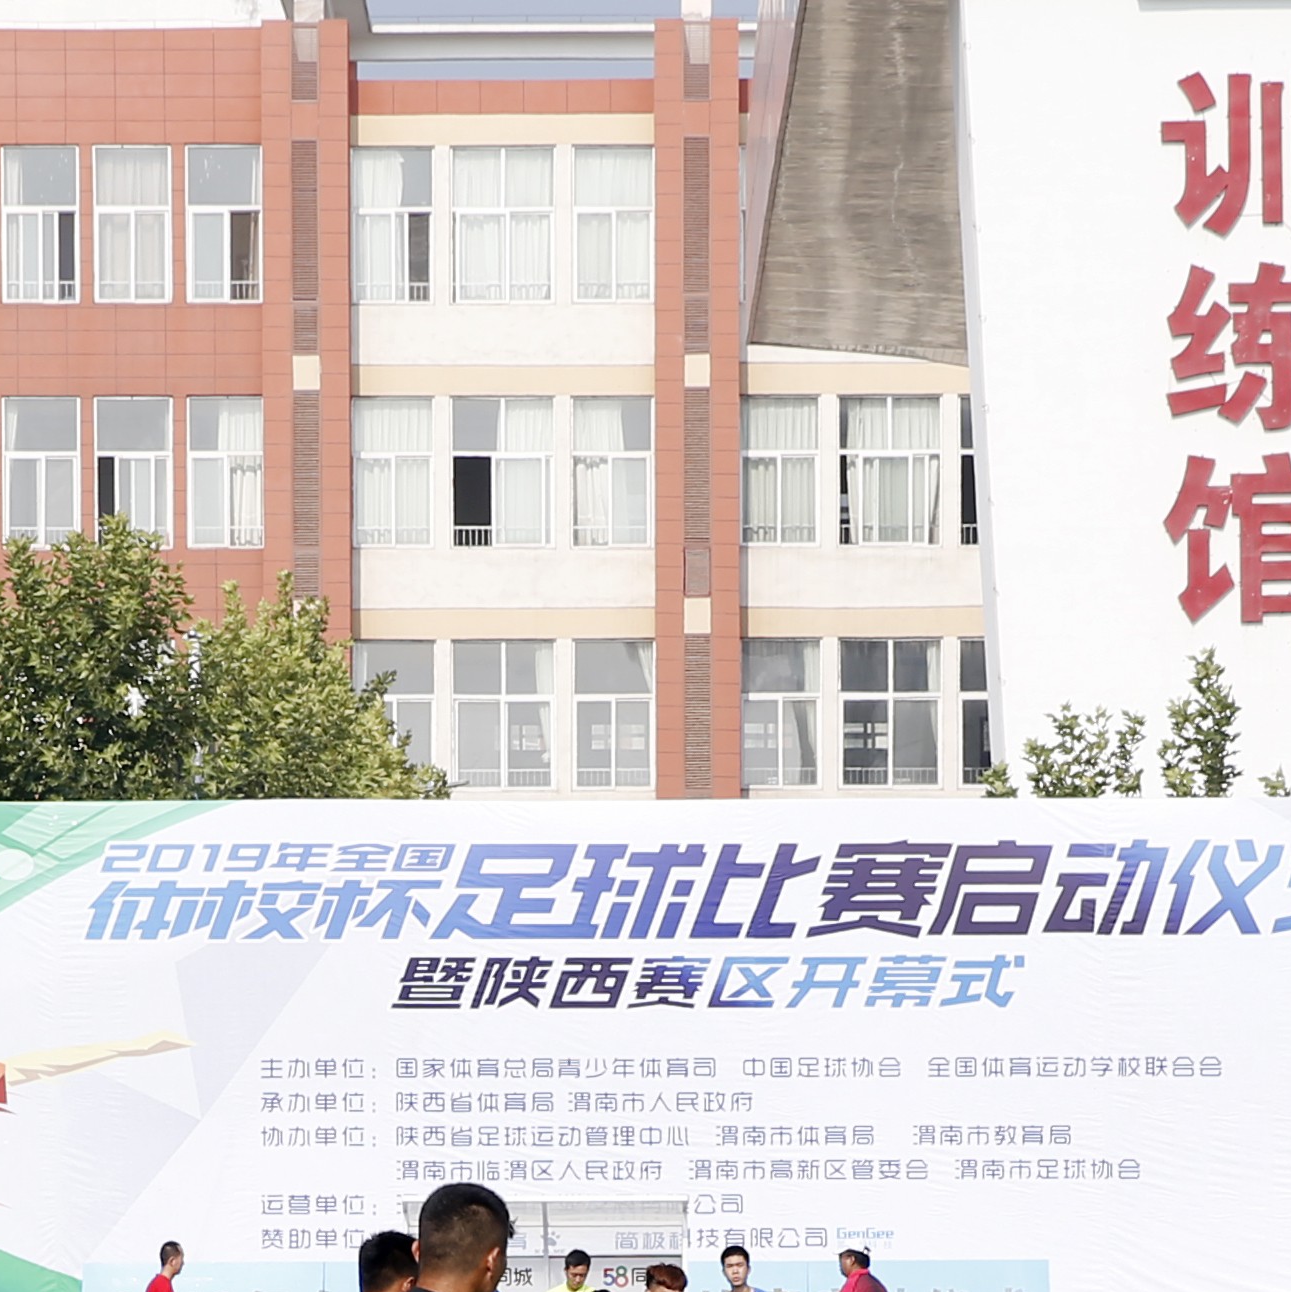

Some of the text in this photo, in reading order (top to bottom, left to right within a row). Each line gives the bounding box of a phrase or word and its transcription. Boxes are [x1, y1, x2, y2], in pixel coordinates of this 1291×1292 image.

[100, 843, 457, 873] 2019年全国
[391, 955, 1026, 1010] 暨陕西赛区开幕式
[396, 1057, 717, 1079] 国家体育总局青少年体育司
[742, 1056, 901, 1078] 中国足球协会
[927, 1056, 1223, 1078] 全国体育运动学校联合会
[396, 1091, 554, 1113] 陕西省体育局
[568, 1091, 753, 1113] 渭南市人民政府
[396, 1125, 690, 1147] 陕西省足球运动管理中心
[715, 1124, 875, 1146] 渭南市体育局
[912, 1124, 1072, 1146] 渭南市教育局
[396, 1158, 1141, 1181] 渭南市临渭区人民政府 渭南市高新区管委会 渭南市足球协会
[836, 1227, 895, 1240] GenGee
